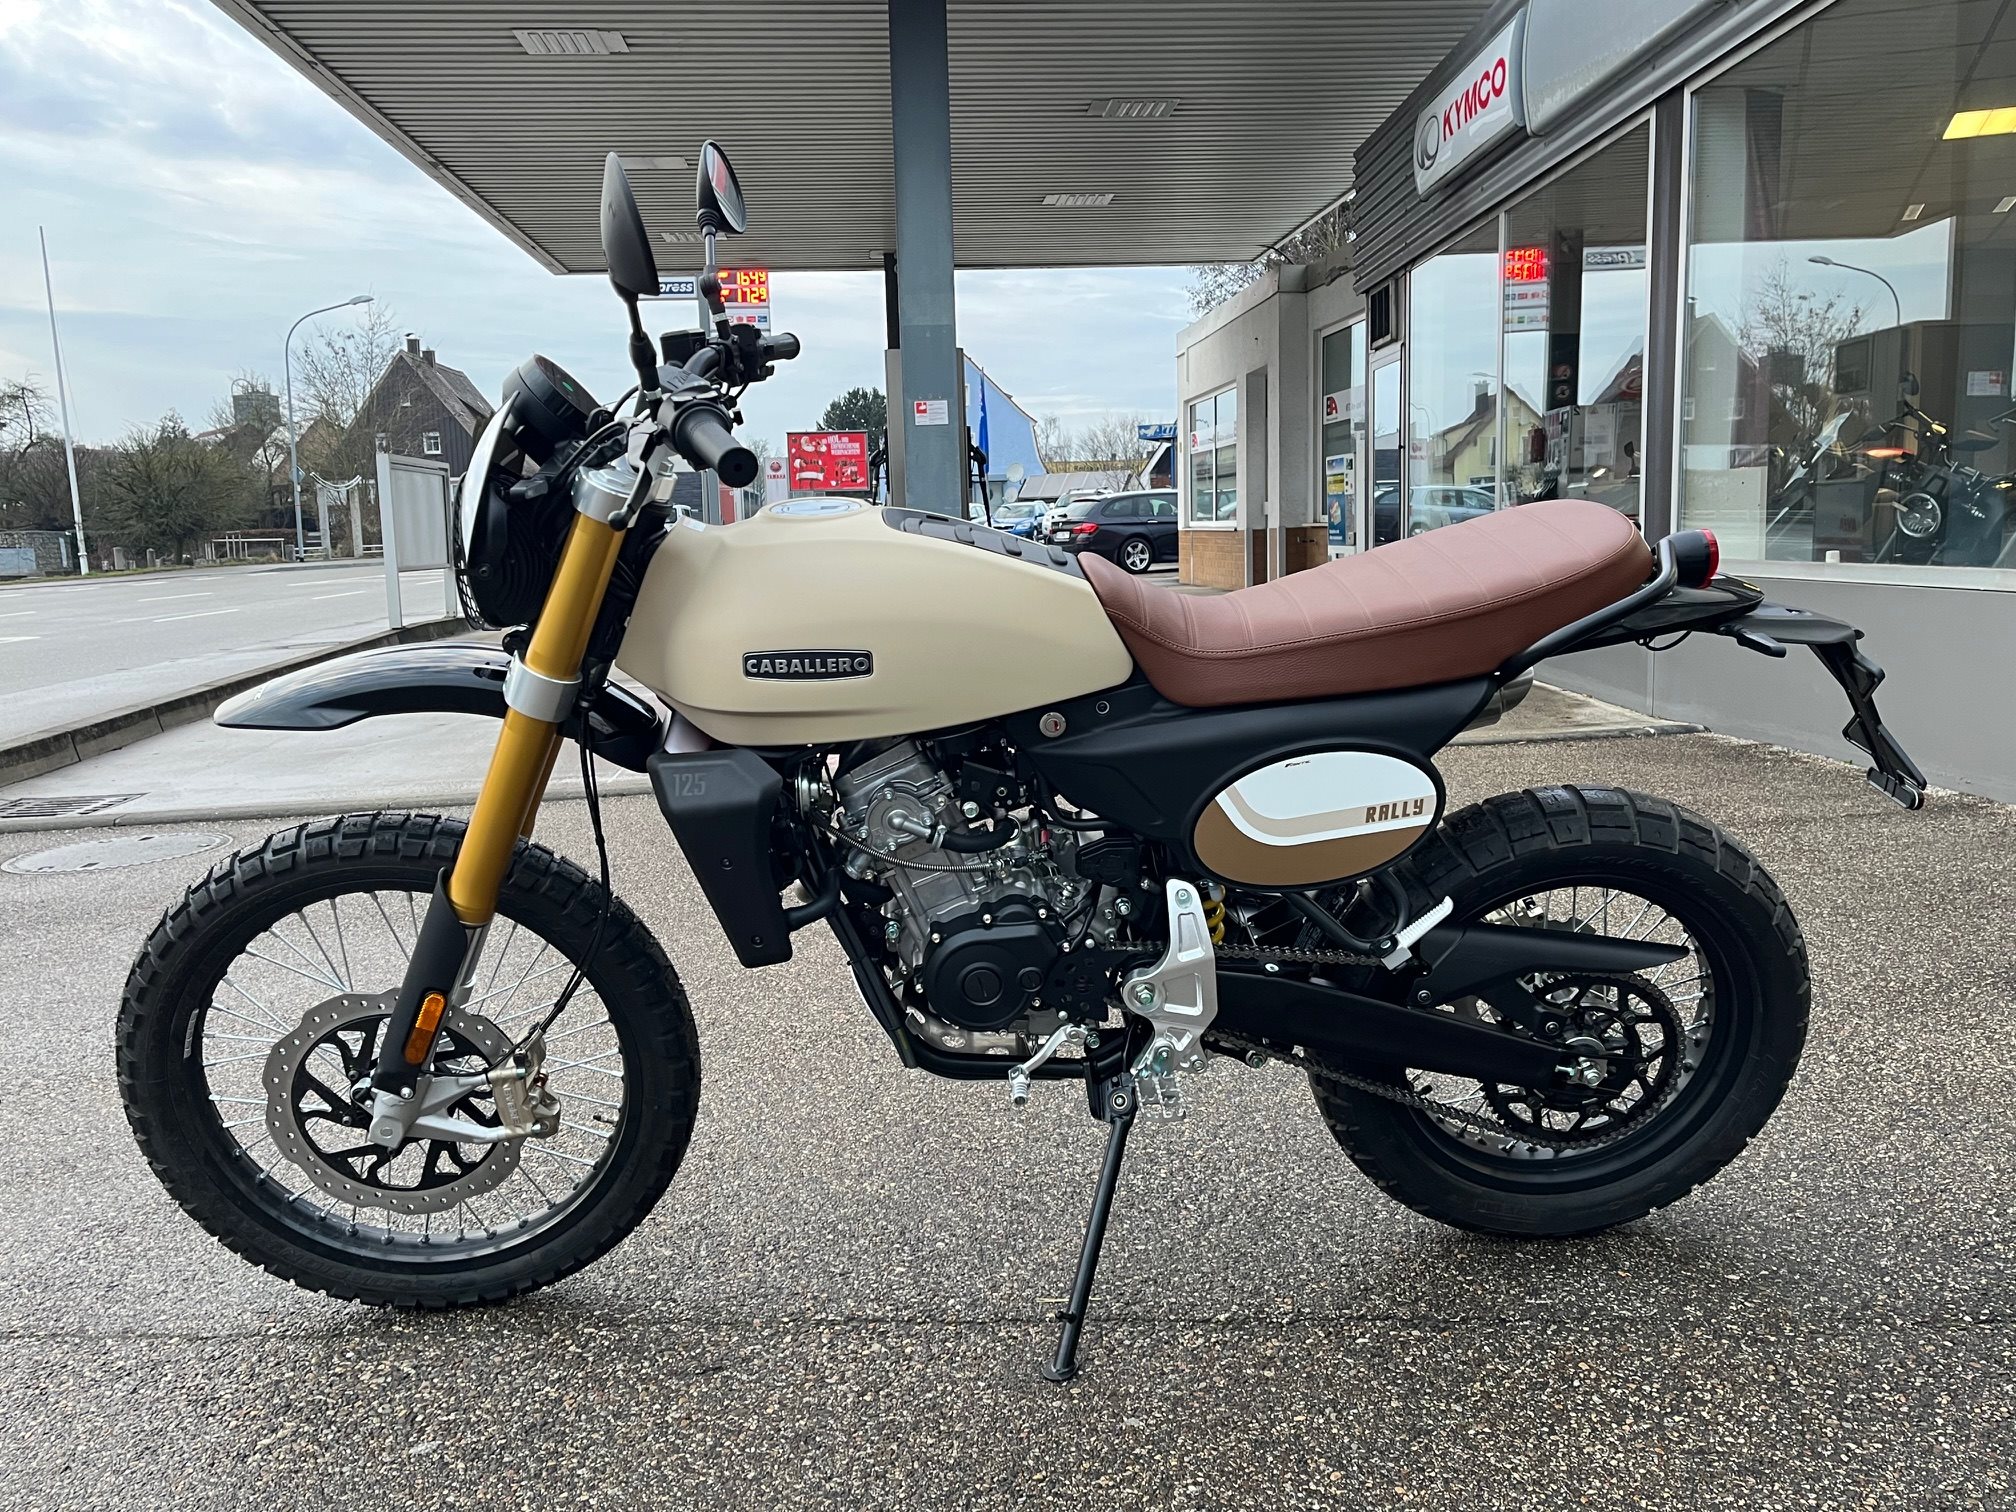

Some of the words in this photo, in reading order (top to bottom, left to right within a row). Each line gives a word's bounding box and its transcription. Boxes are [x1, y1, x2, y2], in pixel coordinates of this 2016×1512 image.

[1442, 57, 1506, 142] KYMCO
[659, 283, 693, 294] press
[737, 287, 767, 304] 1729
[746, 657, 869, 674] CABALLERO
[674, 773, 706, 797] 125
[1365, 799, 1424, 824] RALLY
